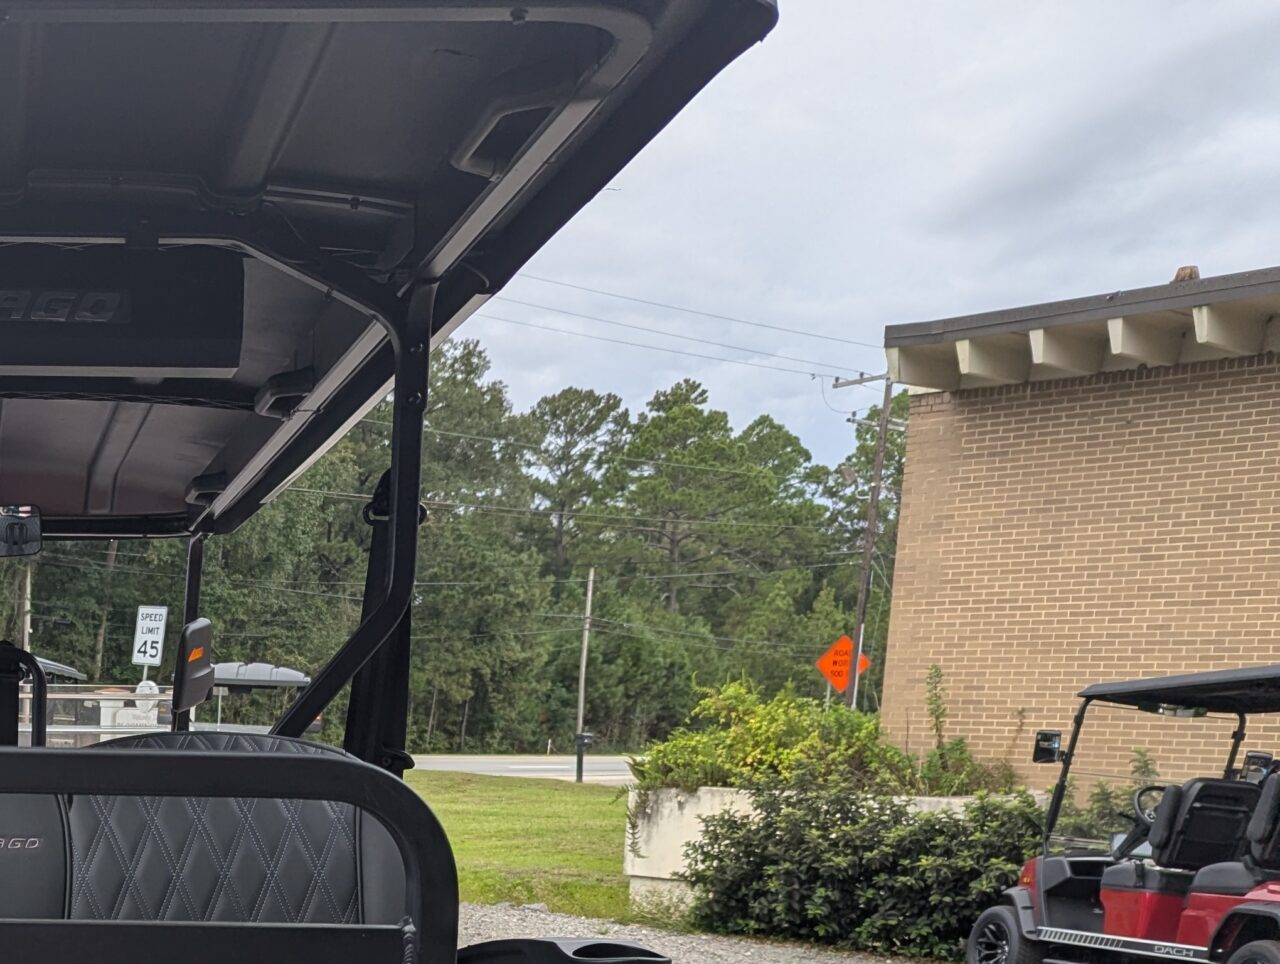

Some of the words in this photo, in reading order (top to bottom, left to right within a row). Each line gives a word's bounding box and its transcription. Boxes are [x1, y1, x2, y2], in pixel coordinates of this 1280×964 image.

[140, 612, 164, 622] SPEED
[141, 626, 160, 635] LIMIT
[137, 640, 159, 658] 45
[833, 649, 850, 657] ROA
[1154, 945, 1194, 957] DACH
